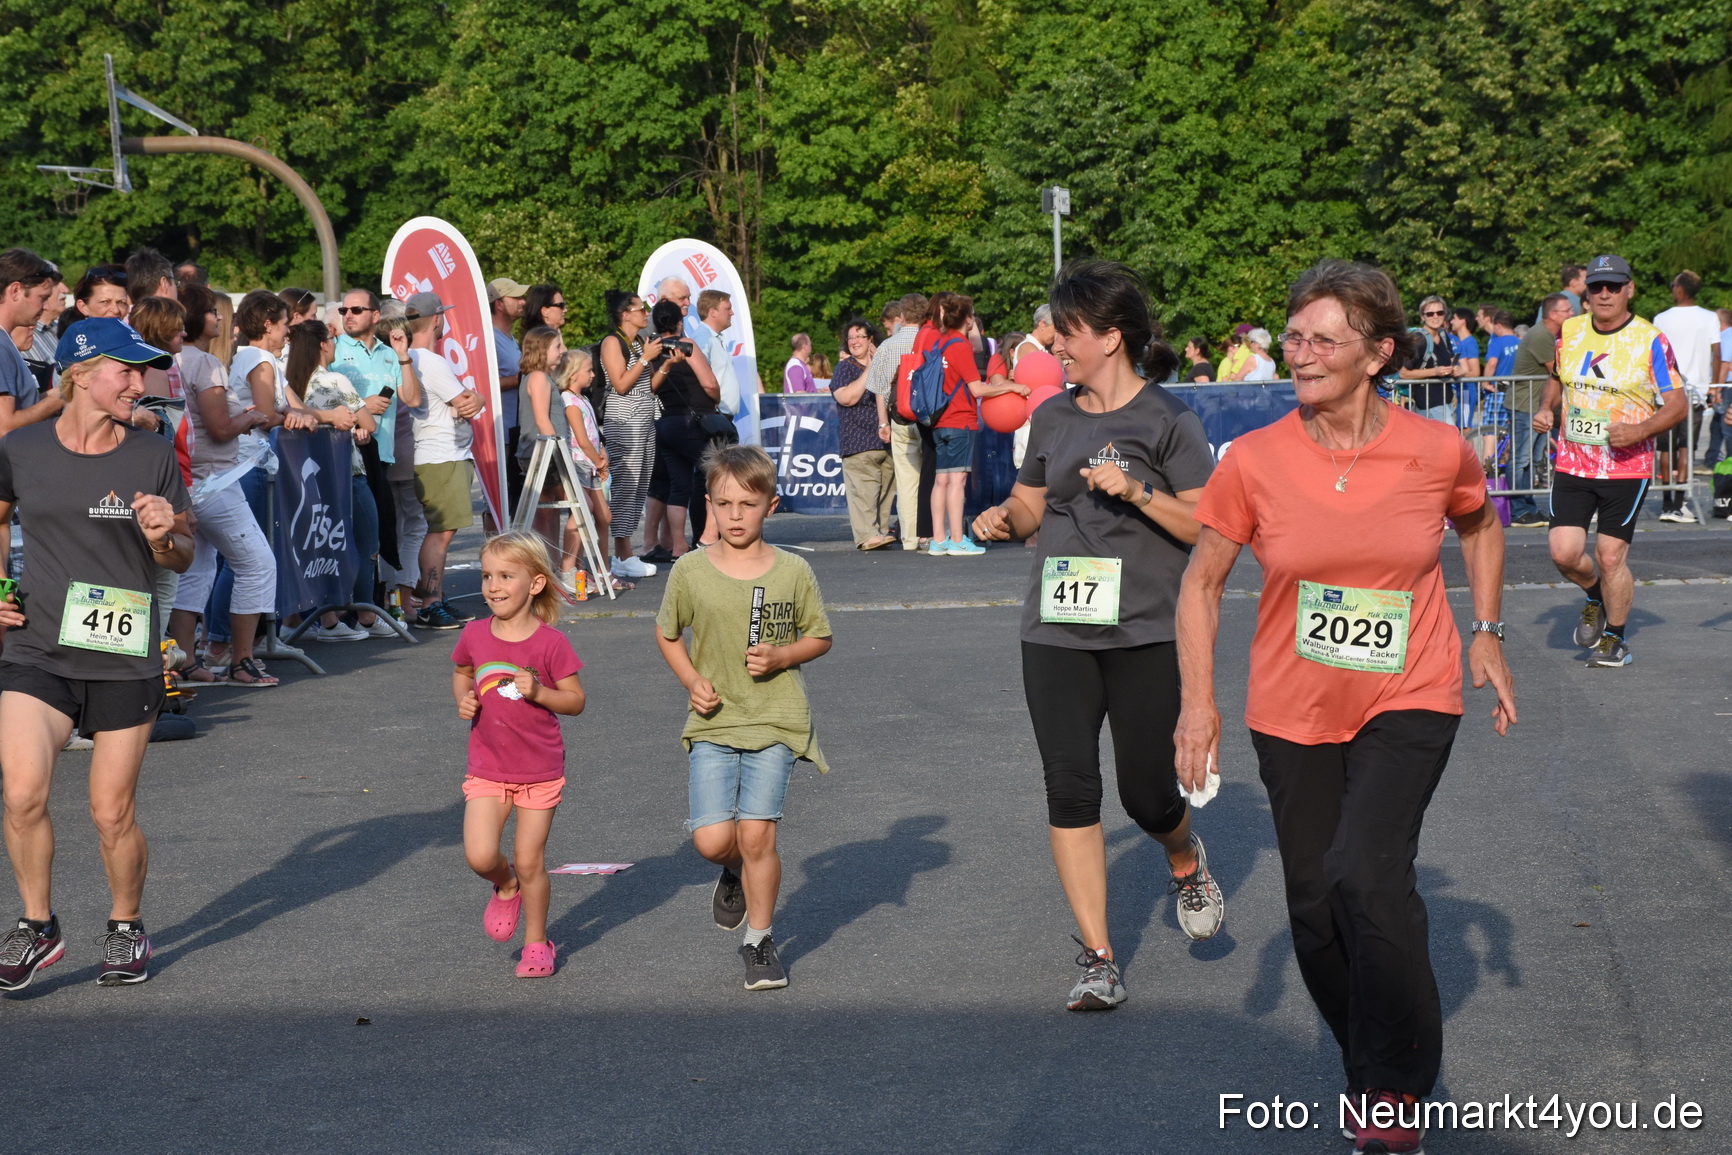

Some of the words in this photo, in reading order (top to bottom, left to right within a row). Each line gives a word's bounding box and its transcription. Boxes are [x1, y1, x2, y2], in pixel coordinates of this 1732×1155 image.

[1571, 418, 1600, 435] 1321
[88, 507, 133, 516] BURKHARDT
[1053, 580, 1099, 605] 417
[1314, 598, 1359, 612] firmenlauf
[82, 608, 133, 636] 416
[1382, 612, 1403, 620] 2019
[90, 632, 108, 641] Heim
[1308, 612, 1393, 649] 2029
[1302, 638, 1340, 654] Walburga
[1369, 649, 1399, 659] Eacker
